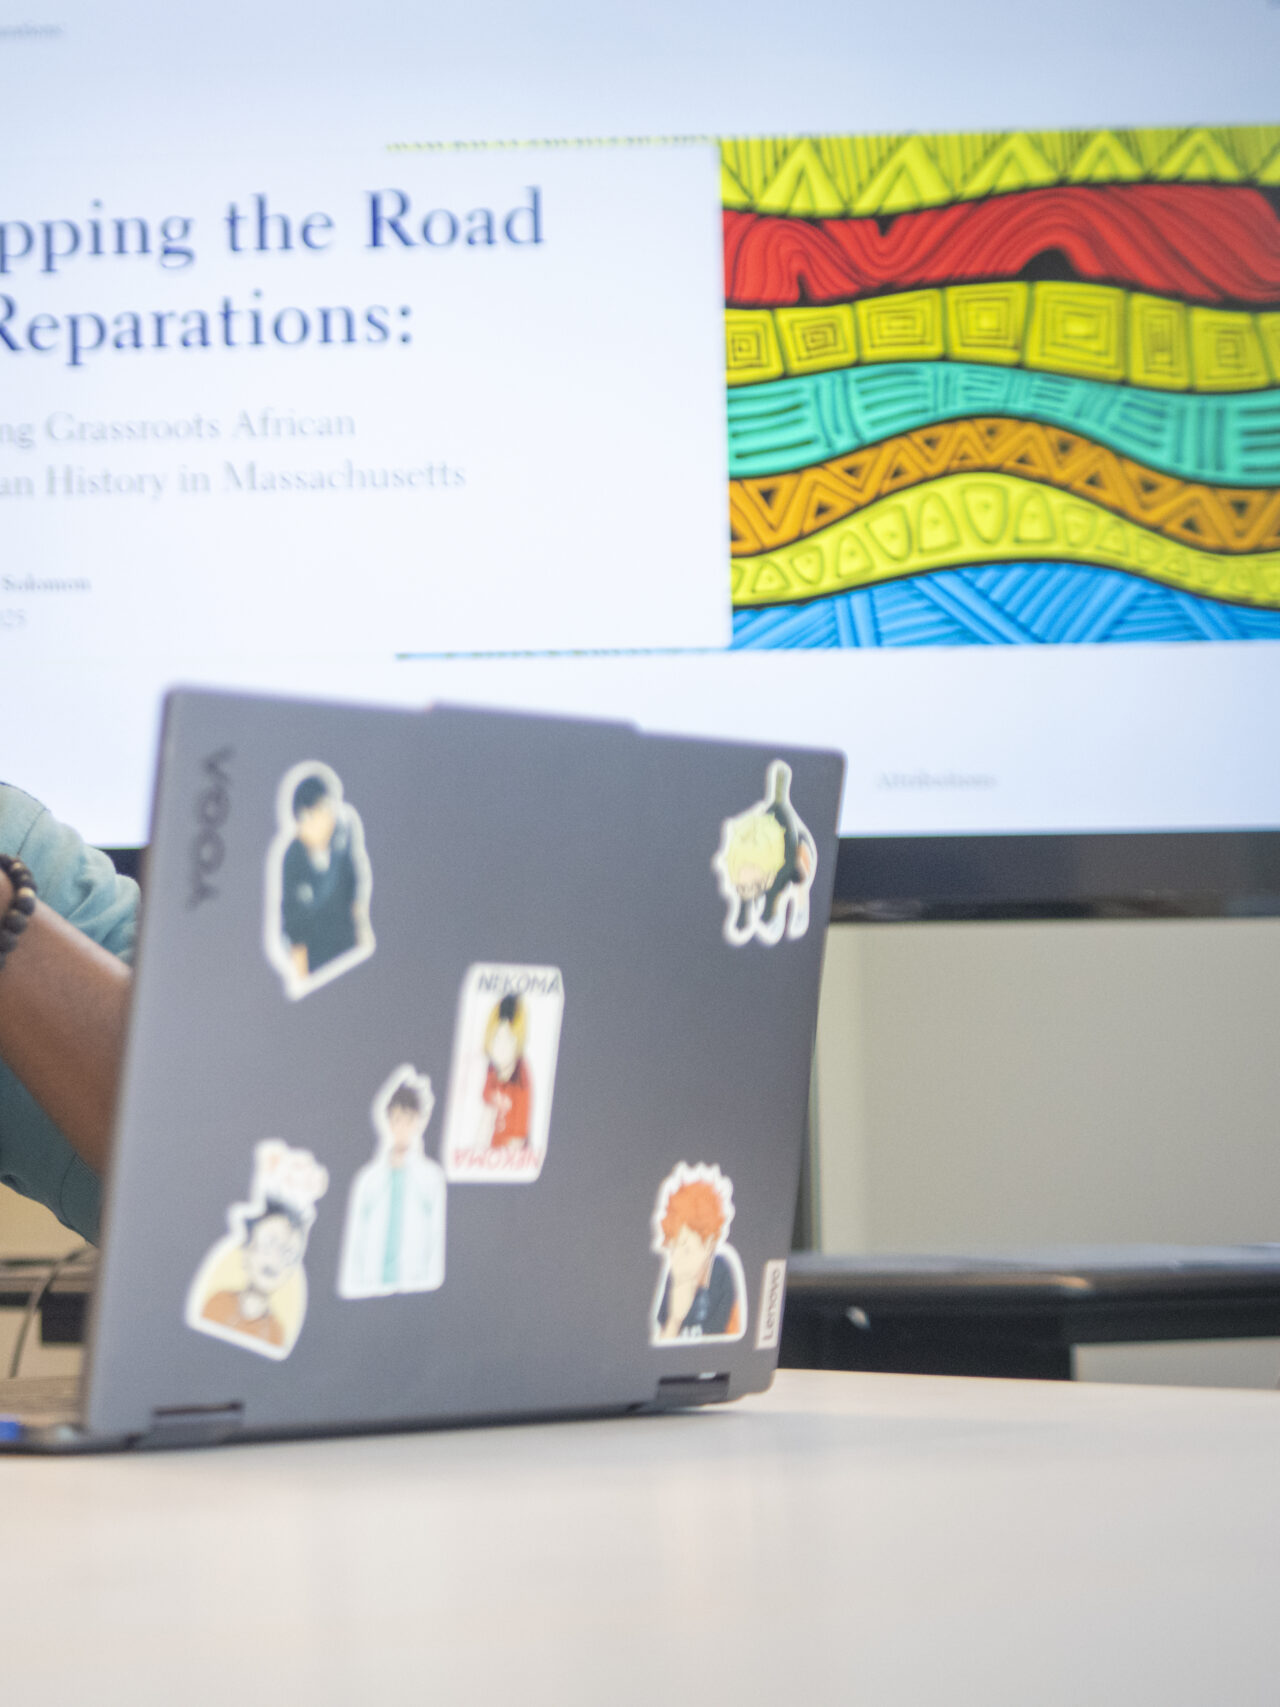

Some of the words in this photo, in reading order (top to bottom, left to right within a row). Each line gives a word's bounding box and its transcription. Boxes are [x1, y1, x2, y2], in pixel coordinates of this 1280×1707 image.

[223, 192, 335, 252] the
[363, 185, 545, 248] Road
[45, 410, 221, 441] Grassroots
[231, 406, 356, 438] African
[45, 463, 166, 502] History
[178, 464, 212, 493] in
[222, 457, 467, 492] Massachusetts
[1, 572, 93, 592] Solomon
[478, 973, 561, 994] NEKOMA
[763, 1268, 782, 1341] Lenovo
